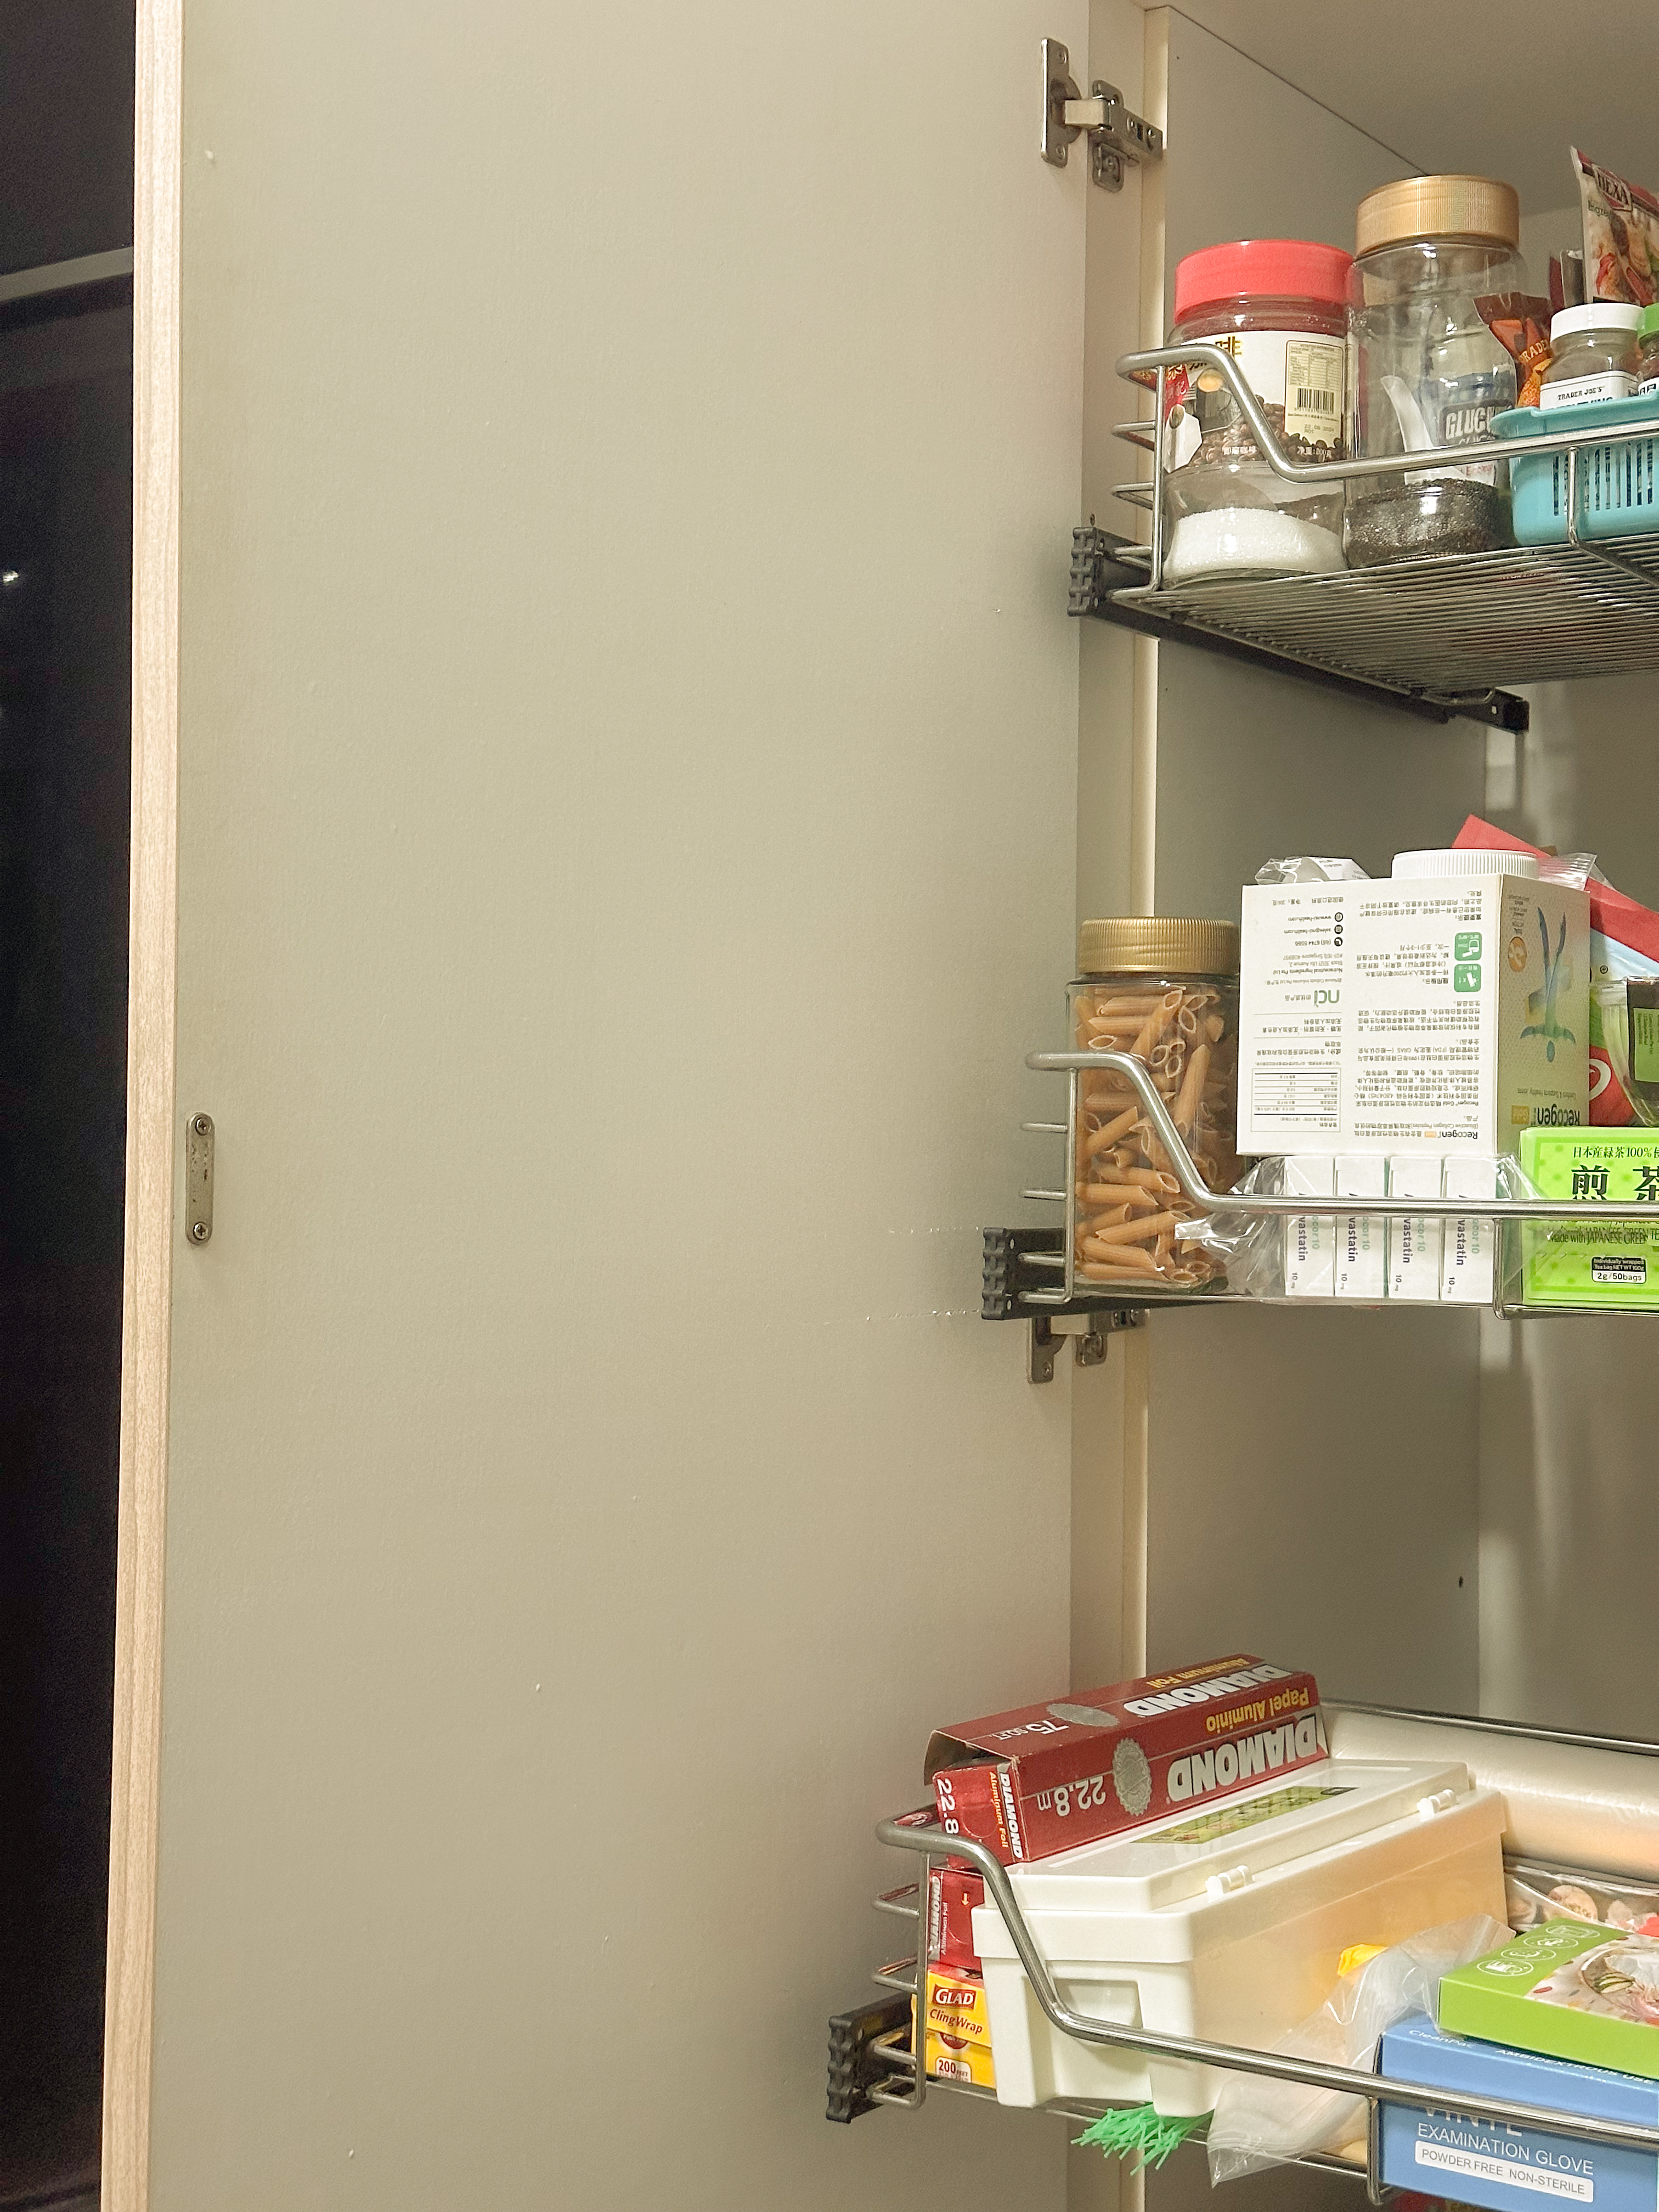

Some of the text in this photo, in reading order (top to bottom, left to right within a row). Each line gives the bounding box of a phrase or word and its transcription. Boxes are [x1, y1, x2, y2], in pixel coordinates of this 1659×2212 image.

[1558, 390, 1582, 400] TRADER
[1313, 990, 1340, 1008] nci
[1537, 1104, 1580, 1126] Recogen
[1442, 1130, 1478, 1139] Recogen
[1299, 1216, 1308, 1261] vastatin
[1312, 1239, 1320, 1250] 10
[1348, 1217, 1358, 1262] vastatin
[1362, 1241, 1370, 1250] 10
[1403, 1218, 1413, 1263] vastatin
[1418, 1241, 1425, 1252] 10
[1456, 1220, 1467, 1266] vastatin
[1471, 1243, 1480, 1254] 10
[1292, 1272, 1298, 1280] 10
[1341, 1273, 1347, 1282] 10
[1396, 1274, 1402, 1283] 10
[1448, 1277, 1455, 1285] 10
[1598, 1272, 1642, 1282] 2g/50bags
[1123, 1664, 1292, 1717] DIAMOND
[1206, 1687, 1310, 1733] Papel Aluminio
[1025, 1720, 1069, 1734] 75
[1167, 1713, 1317, 1802] DIAMOND
[1054, 1775, 1106, 1817] 22.8
[936, 1778, 959, 1834] 22.8
[990, 1772, 1009, 1849] Aluminum Foil
[1000, 1773, 1023, 1859] DIAMOND
[935, 1988, 974, 2005] GLAD
[939, 2059, 956, 2074] 200
[1418, 2122, 1594, 2175] EXAMINATION GLOVE
[1422, 2148, 1585, 2195] POWDER FREE NON-STERILE
